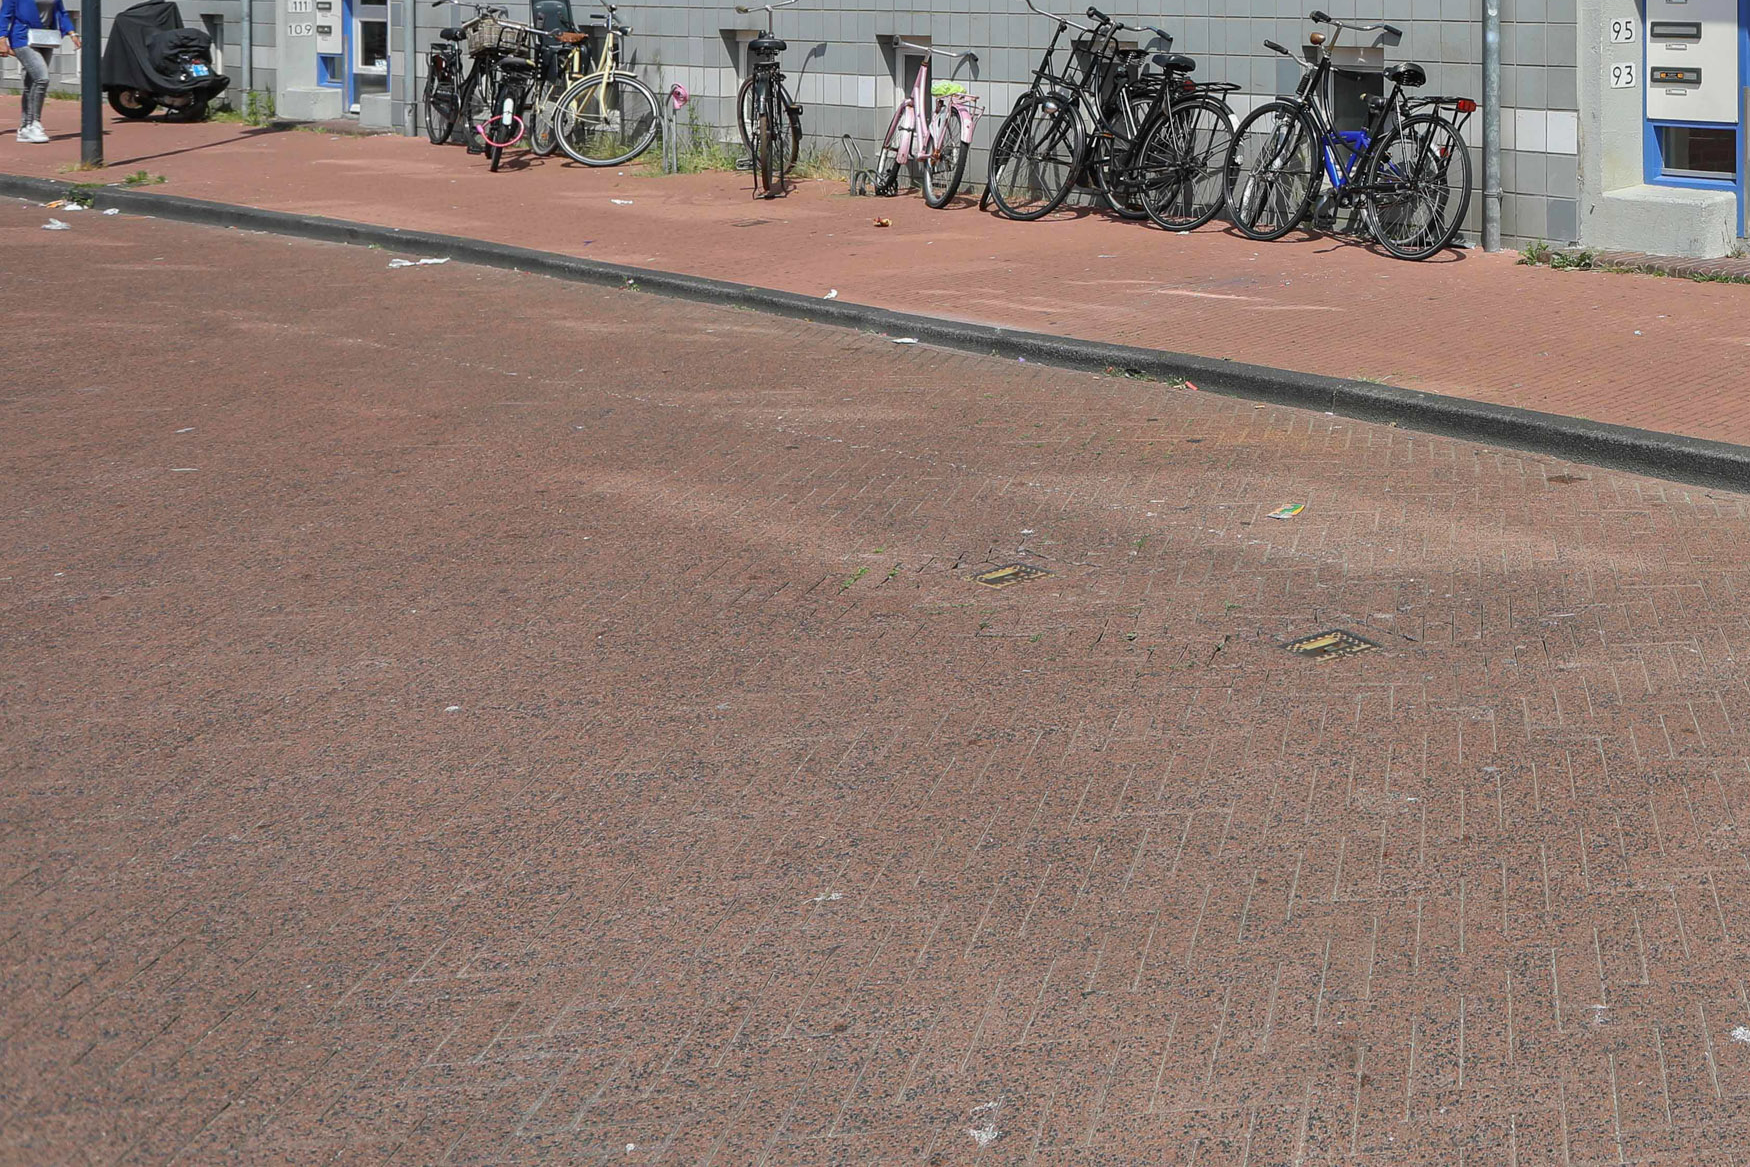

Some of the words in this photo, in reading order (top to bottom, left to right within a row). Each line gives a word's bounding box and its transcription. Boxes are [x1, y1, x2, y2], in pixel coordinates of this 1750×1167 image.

[293, 0, 308, 11] 111
[288, 24, 312, 35] 109
[1612, 21, 1633, 41] 95
[1612, 65, 1634, 86] 93
